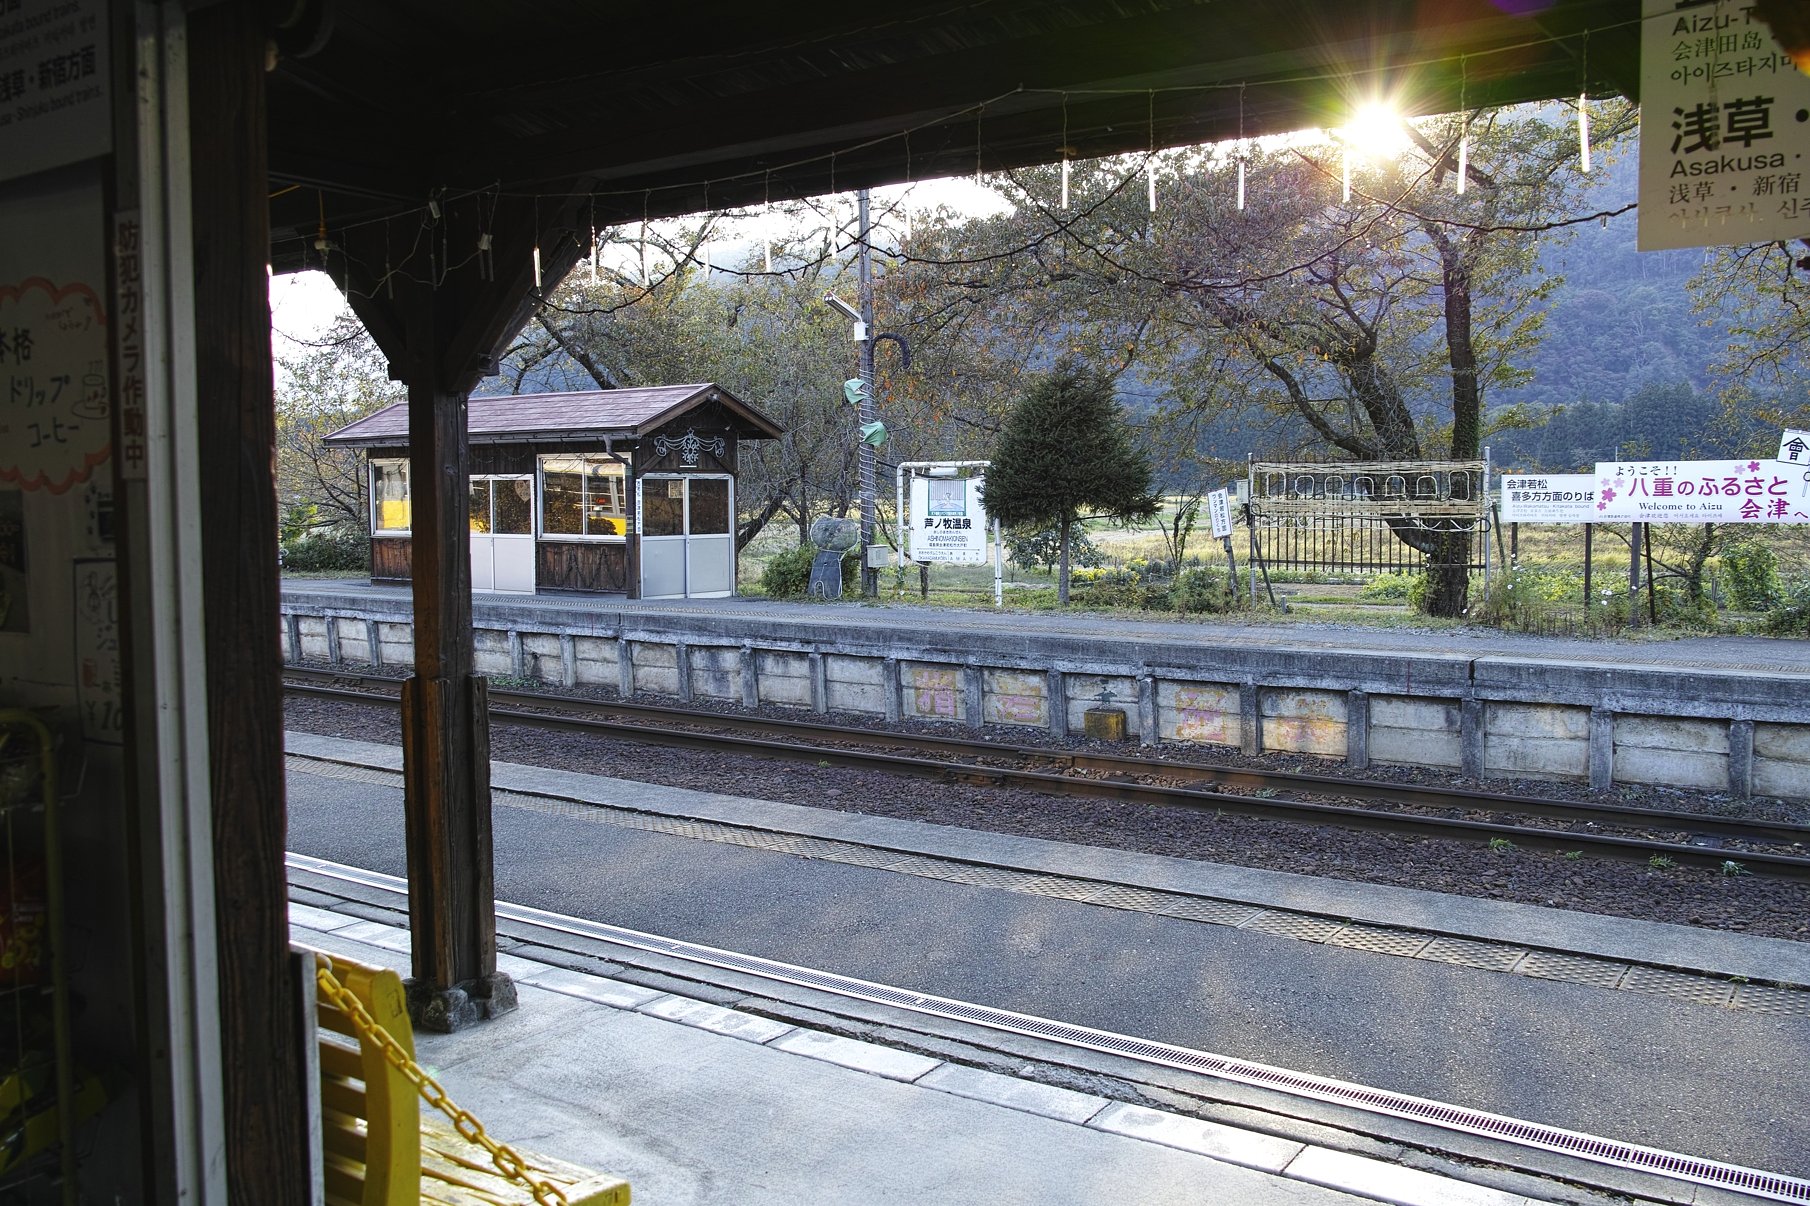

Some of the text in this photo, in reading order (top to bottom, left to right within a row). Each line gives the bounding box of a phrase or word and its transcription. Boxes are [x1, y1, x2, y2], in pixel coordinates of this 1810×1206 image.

[1671, 6, 1752, 36] Aizu-T
[1670, 153, 1785, 178] Asakusa
[118, 220, 144, 470] 防犯カメラ作動中
[11, 375, 70, 408] ドリップ
[27, 416, 79, 448] コーヒー
[1506, 479, 1548, 490] 会津若松
[1628, 477, 1789, 497] 八重のふるさと
[1511, 490, 1594, 502] 喜多方方面のりば
[1639, 502, 1724, 511] Welcome to Aizu
[924, 517, 972, 530] 芦ノ牧温泉
